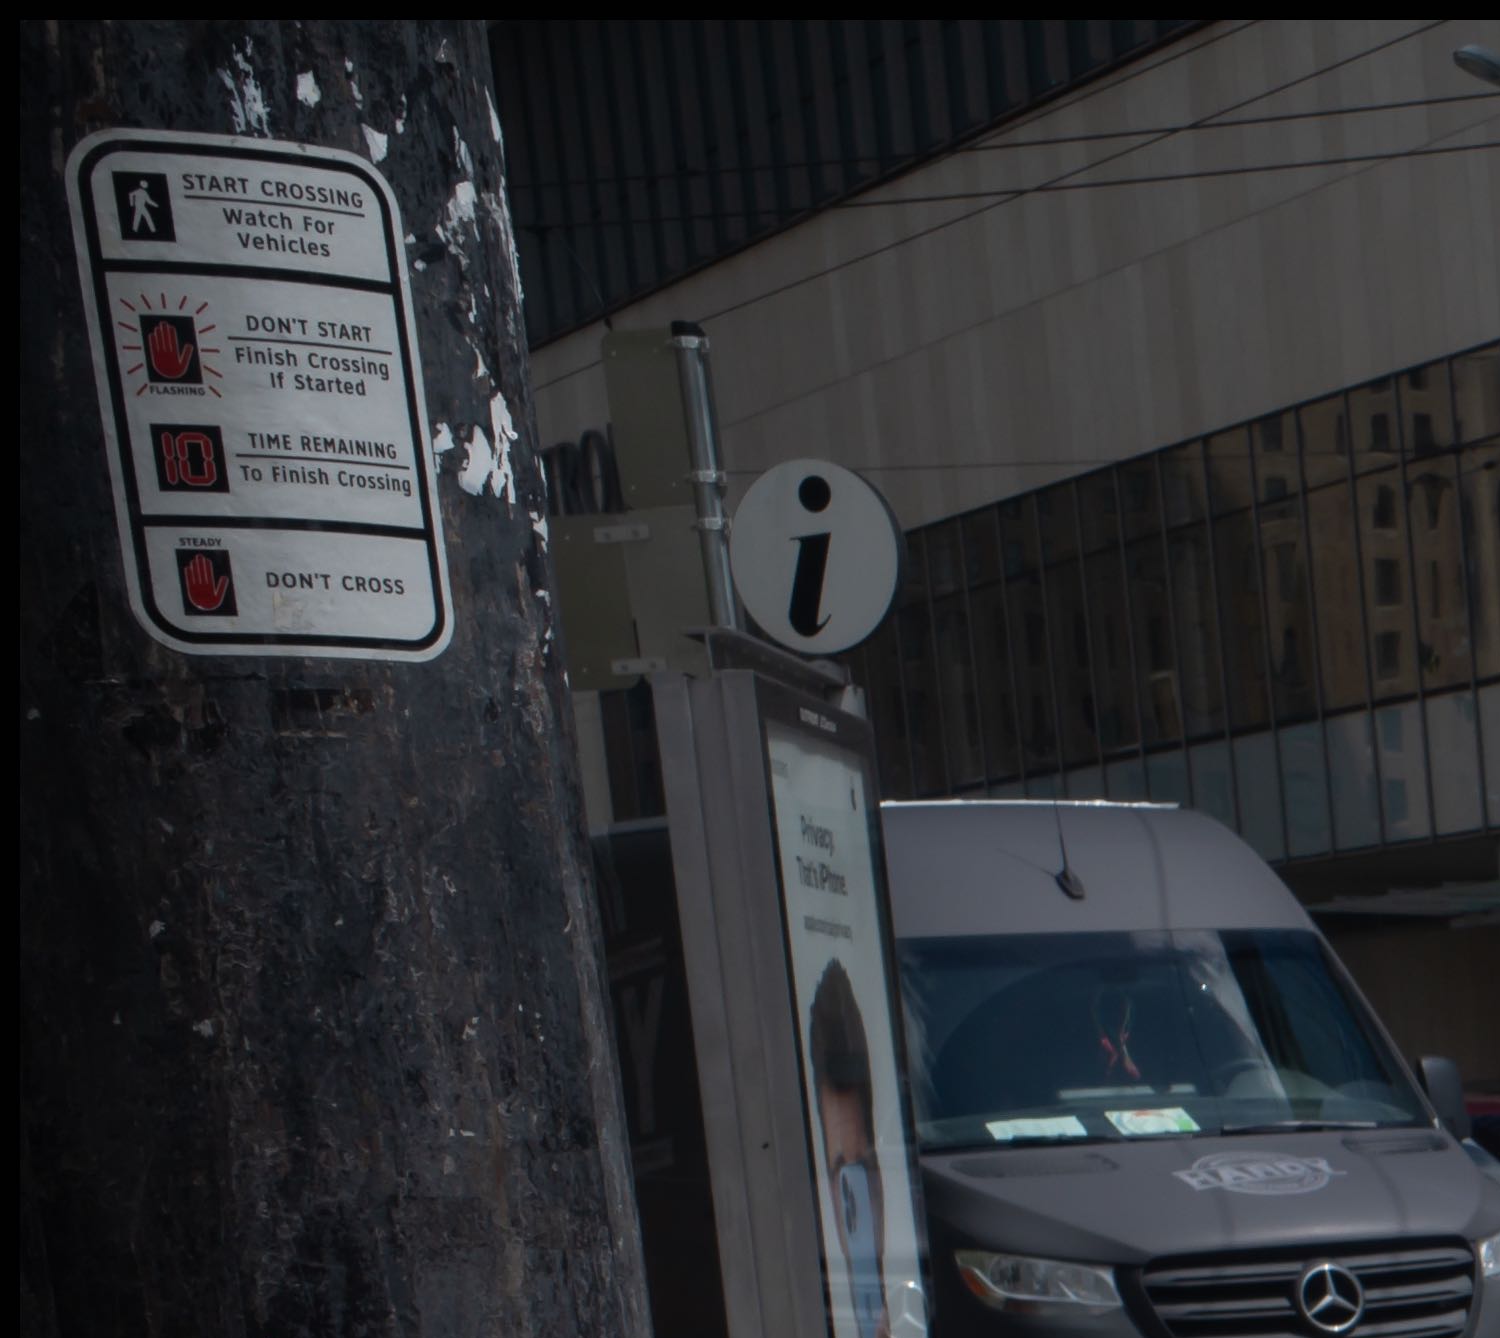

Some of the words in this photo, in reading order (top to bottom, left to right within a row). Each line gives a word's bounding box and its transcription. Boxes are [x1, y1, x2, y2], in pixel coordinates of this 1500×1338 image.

[182, 173, 249, 196] START
[260, 179, 364, 209] CROSSING
[222, 208, 293, 231] Watch
[303, 216, 335, 236] For
[237, 232, 331, 258] Vehicles
[246, 315, 308, 337] DON'T
[317, 322, 372, 344] START
[234, 347, 298, 369] Finish
[307, 353, 390, 382] Crossing
[149, 385, 206, 396] FLASHING
[270, 372, 287, 389] If
[294, 374, 367, 397] Started
[161, 431, 217, 486] 10
[248, 432, 292, 451] TIME
[301, 436, 398, 461] REMAINING
[240, 465, 263, 483] To
[272, 466, 330, 487] Finish
[337, 471, 412, 497] Crossing
[179, 538, 222, 547] STEADY
[266, 571, 332, 591] DON'T
[341, 575, 405, 595] CROSS
